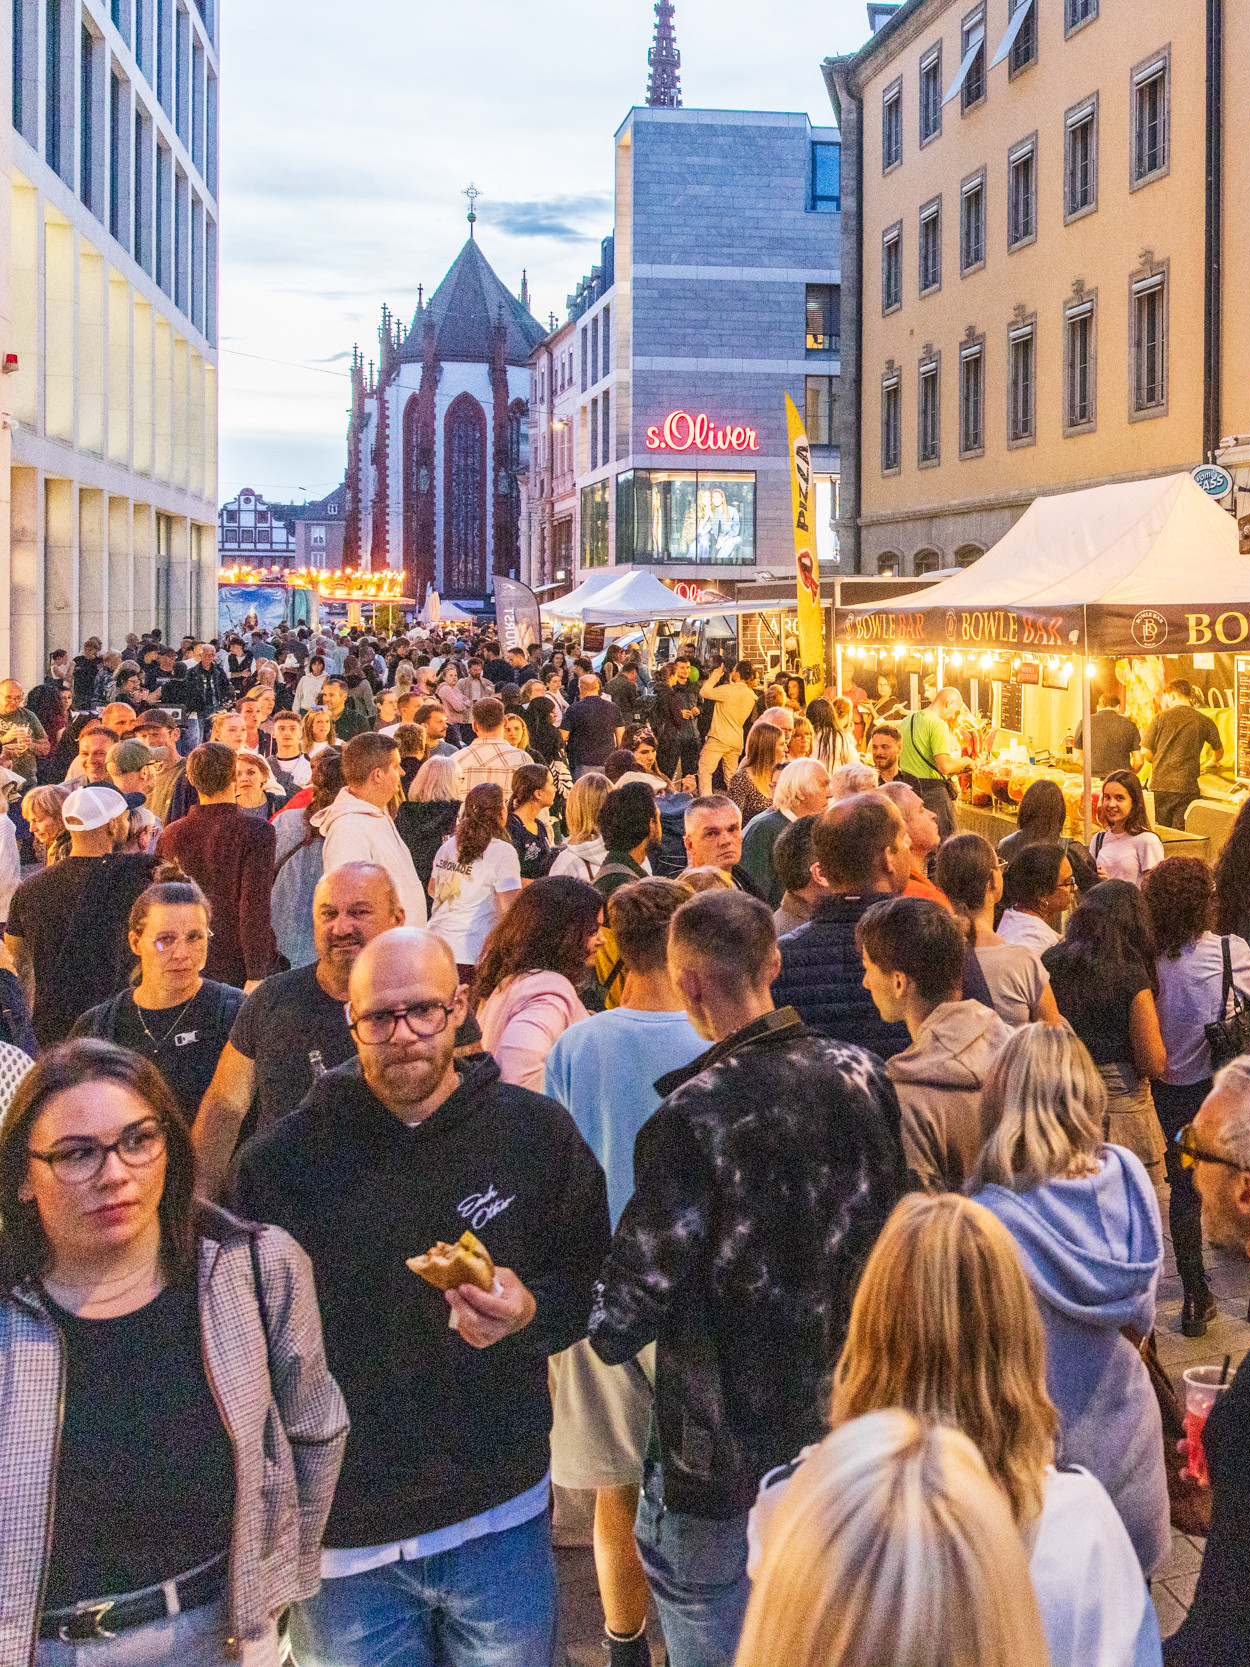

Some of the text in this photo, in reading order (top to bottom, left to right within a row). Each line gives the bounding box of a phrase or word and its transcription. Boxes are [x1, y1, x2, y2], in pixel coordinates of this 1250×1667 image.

[646, 410, 759, 450] s.Oliver
[796, 445, 810, 532] PIZZA
[856, 614, 895, 640] BOWLE
[899, 613, 925, 639] BAR
[961, 610, 1018, 642] BOWLE
[1022, 615, 1063, 645] BAR
